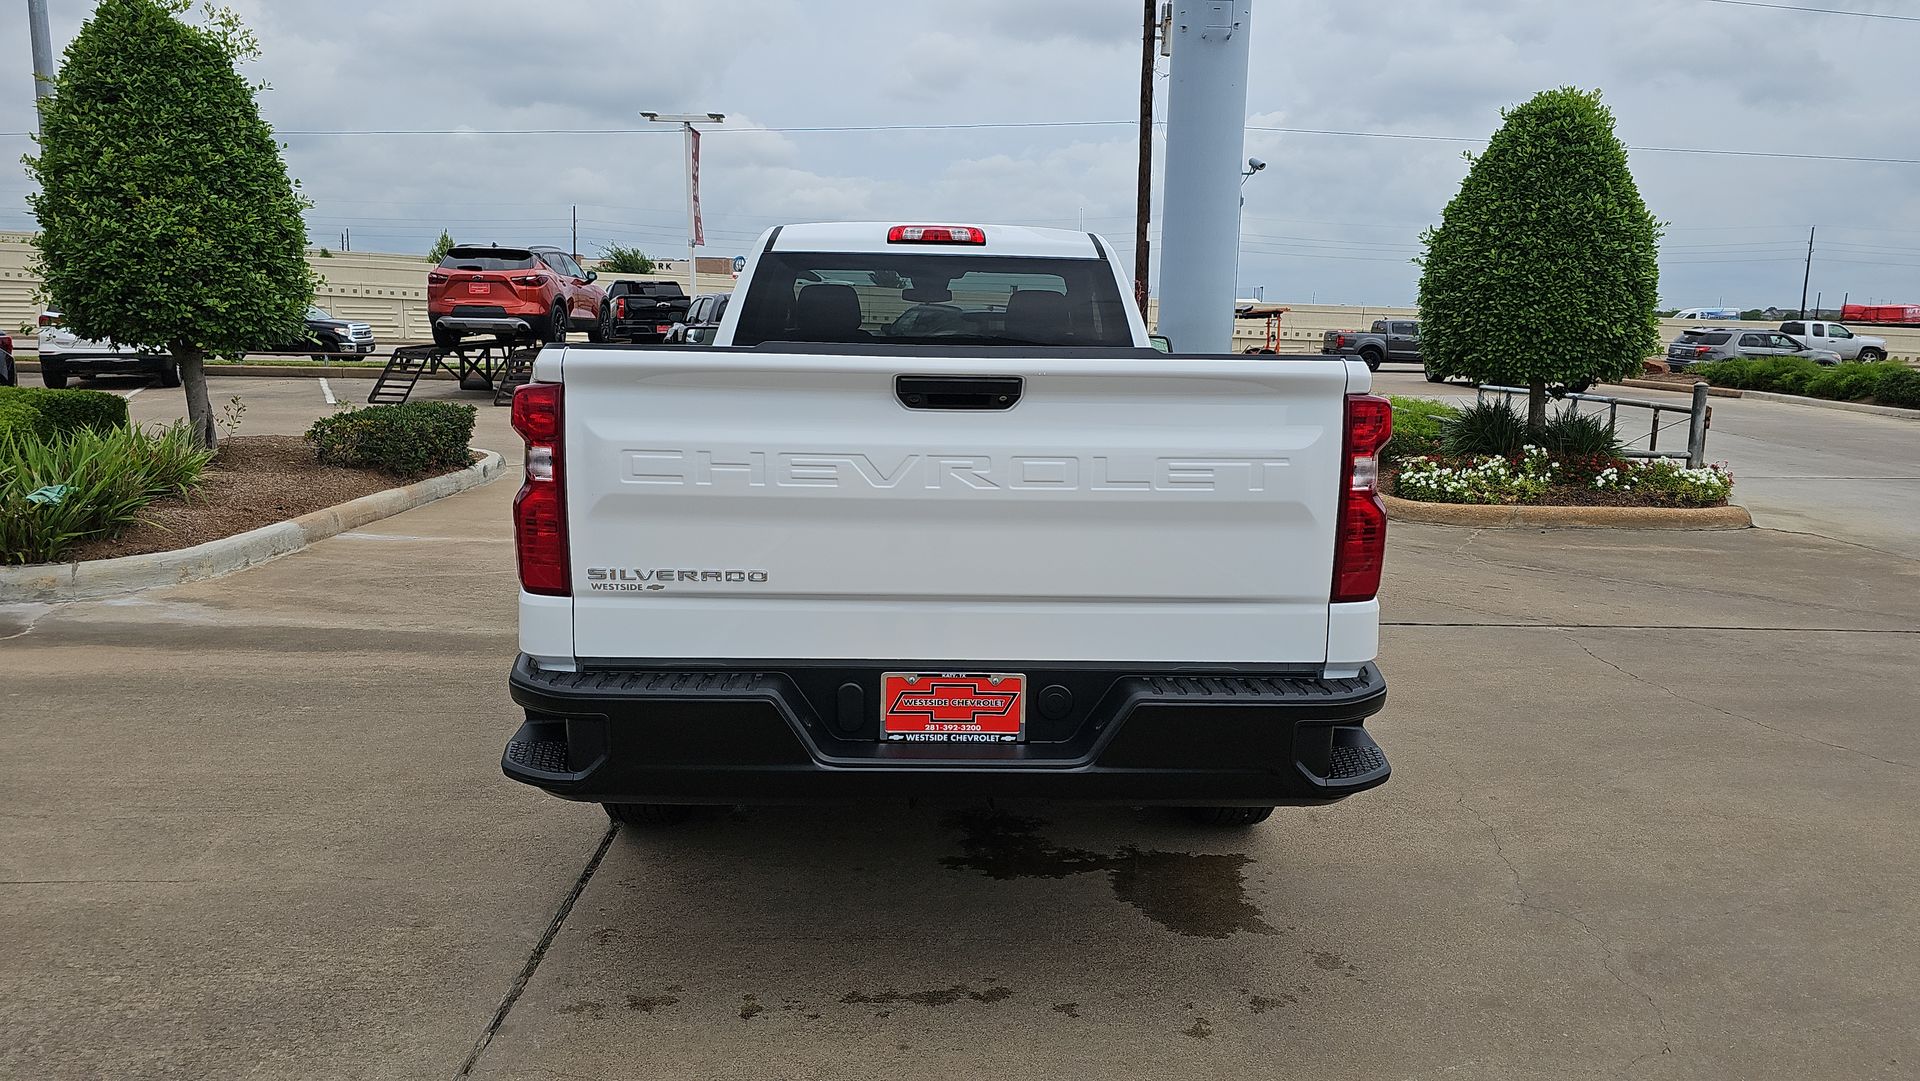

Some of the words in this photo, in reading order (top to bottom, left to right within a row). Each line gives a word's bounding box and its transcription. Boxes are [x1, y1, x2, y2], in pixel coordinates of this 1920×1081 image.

[619, 449, 1291, 493] CHEVROLET
[587, 568, 769, 583] SILVERADO
[591, 583, 643, 591] WESTSIDE
[902, 699, 949, 707] WESTSIDE
[950, 699, 1005, 707] CHEVROLET
[905, 734, 948, 742] WESTSIDE
[950, 734, 1001, 743] CHEVROLET
